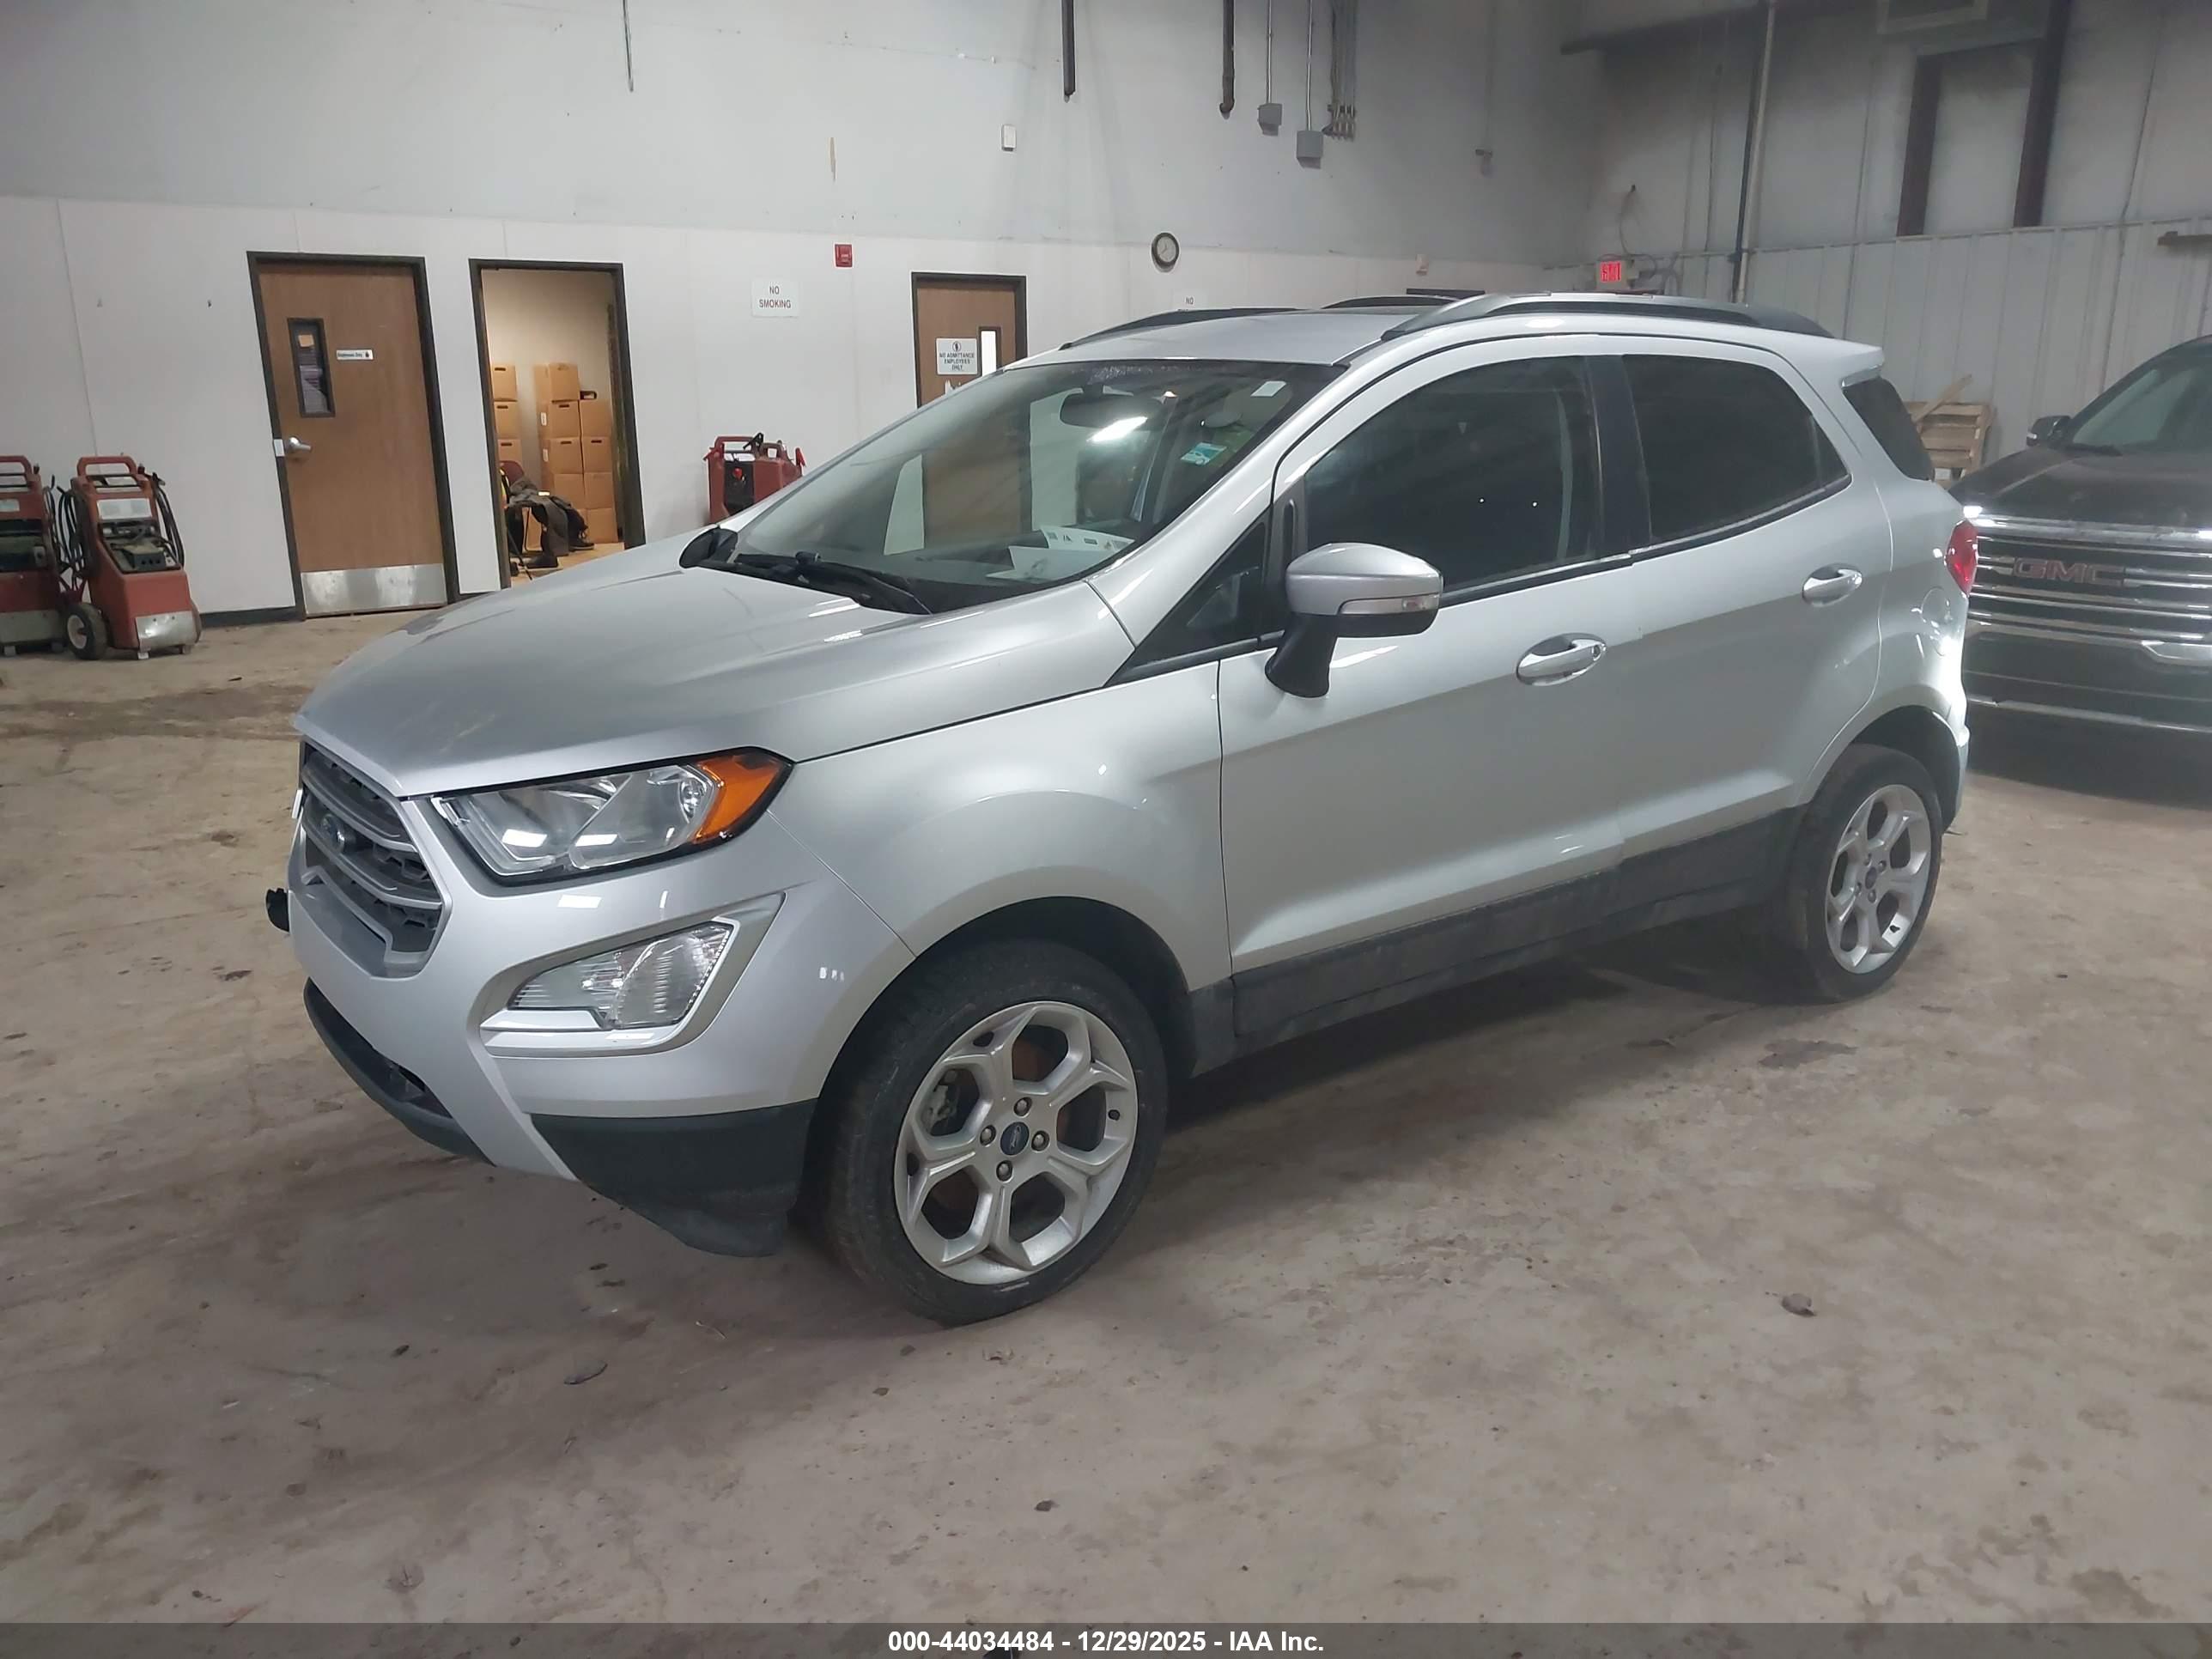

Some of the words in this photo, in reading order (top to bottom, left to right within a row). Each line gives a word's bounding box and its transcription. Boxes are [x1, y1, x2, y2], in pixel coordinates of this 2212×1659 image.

[769, 285, 780, 295] NO
[759, 299, 791, 308] SMOKING
[2014, 558, 2124, 587] GMC
